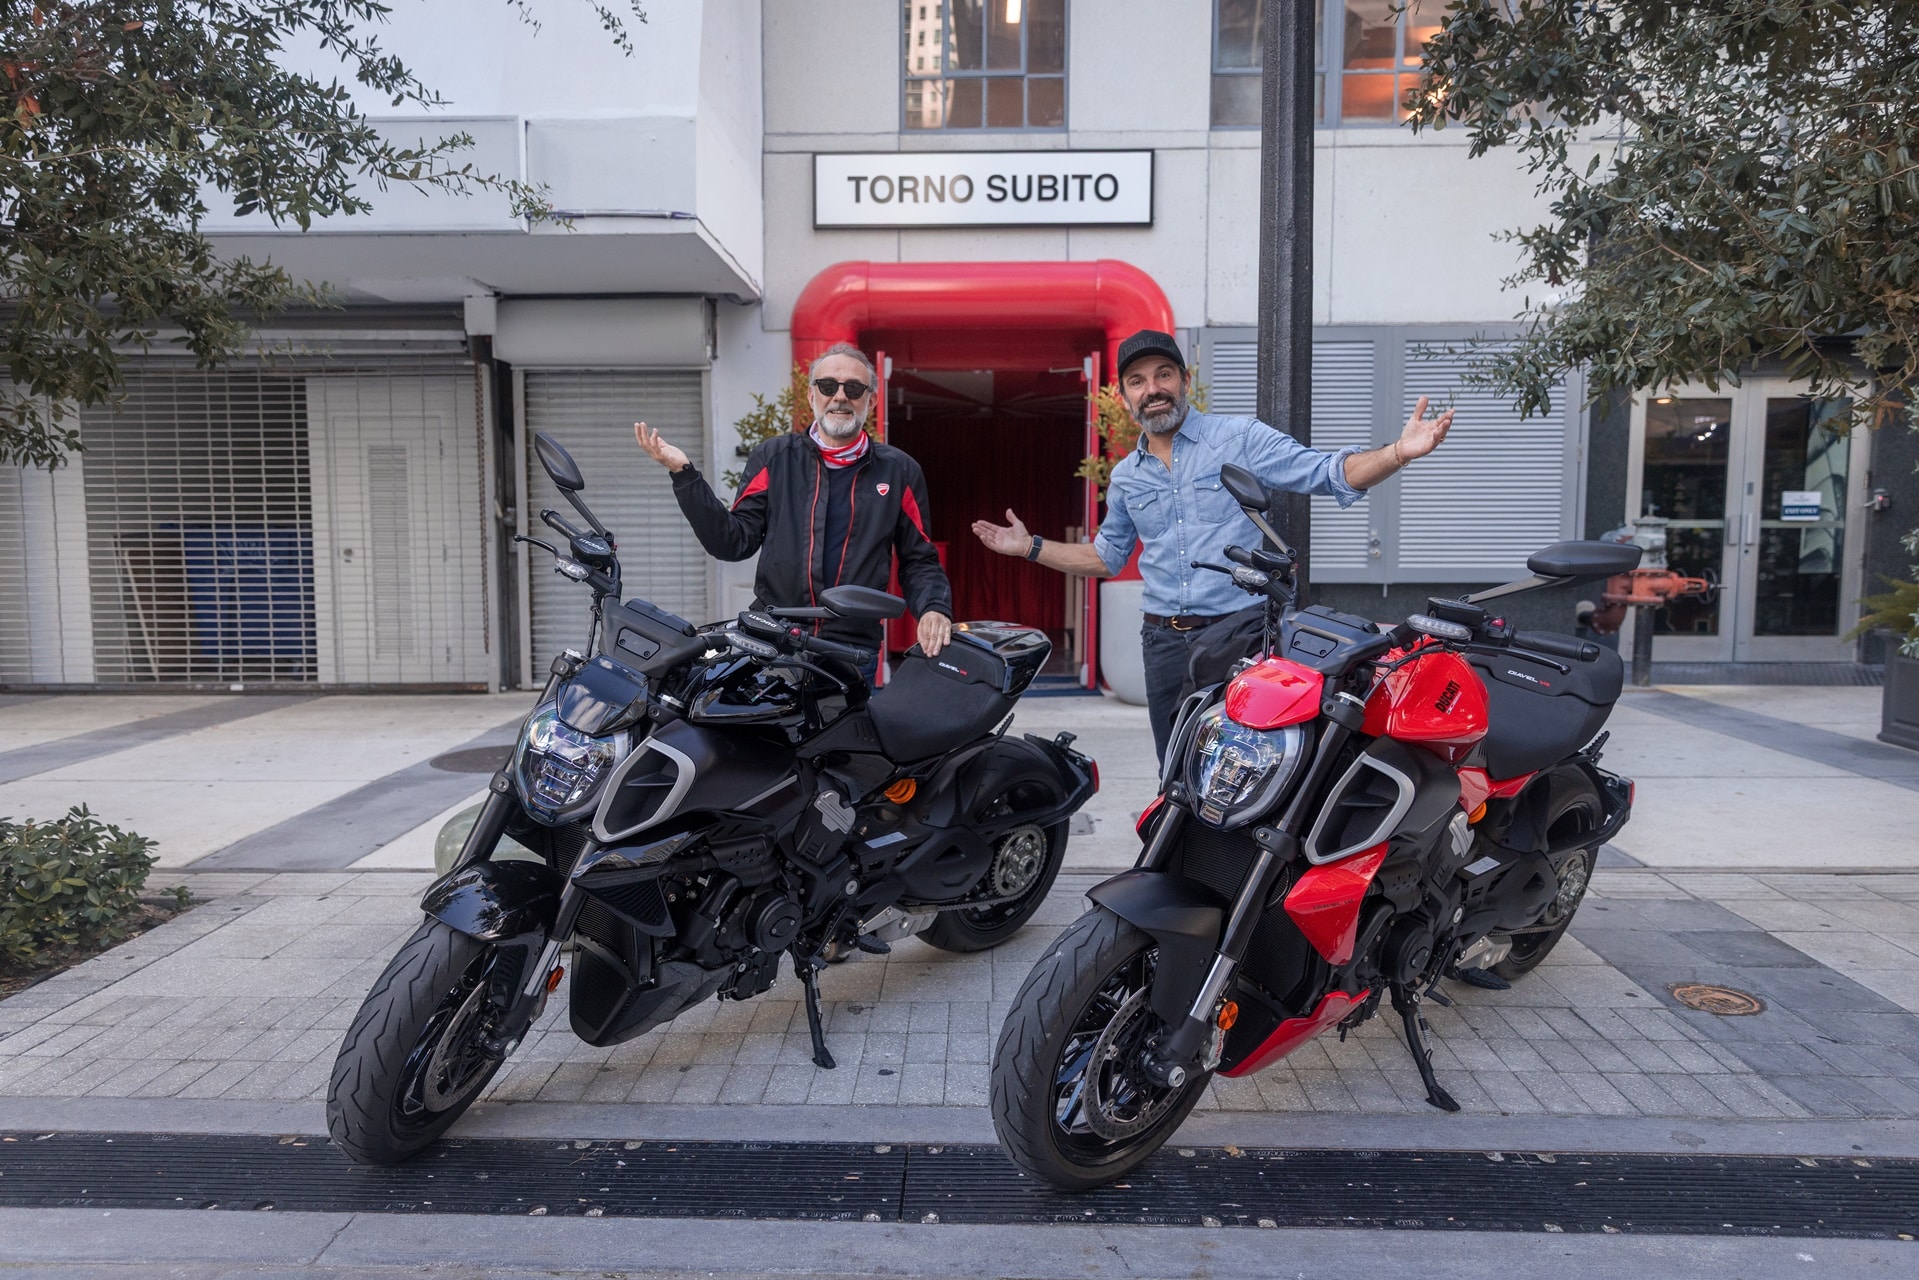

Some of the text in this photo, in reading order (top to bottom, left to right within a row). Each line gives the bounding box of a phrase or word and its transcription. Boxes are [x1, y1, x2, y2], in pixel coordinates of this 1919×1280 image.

[847, 173, 1119, 204] TORNO SUBITO
[578, 538, 605, 551] DUCATI
[748, 614, 777, 628] DUCATI
[1507, 669, 1538, 683] DIAVEL
[1434, 679, 1462, 713] DUCATI
